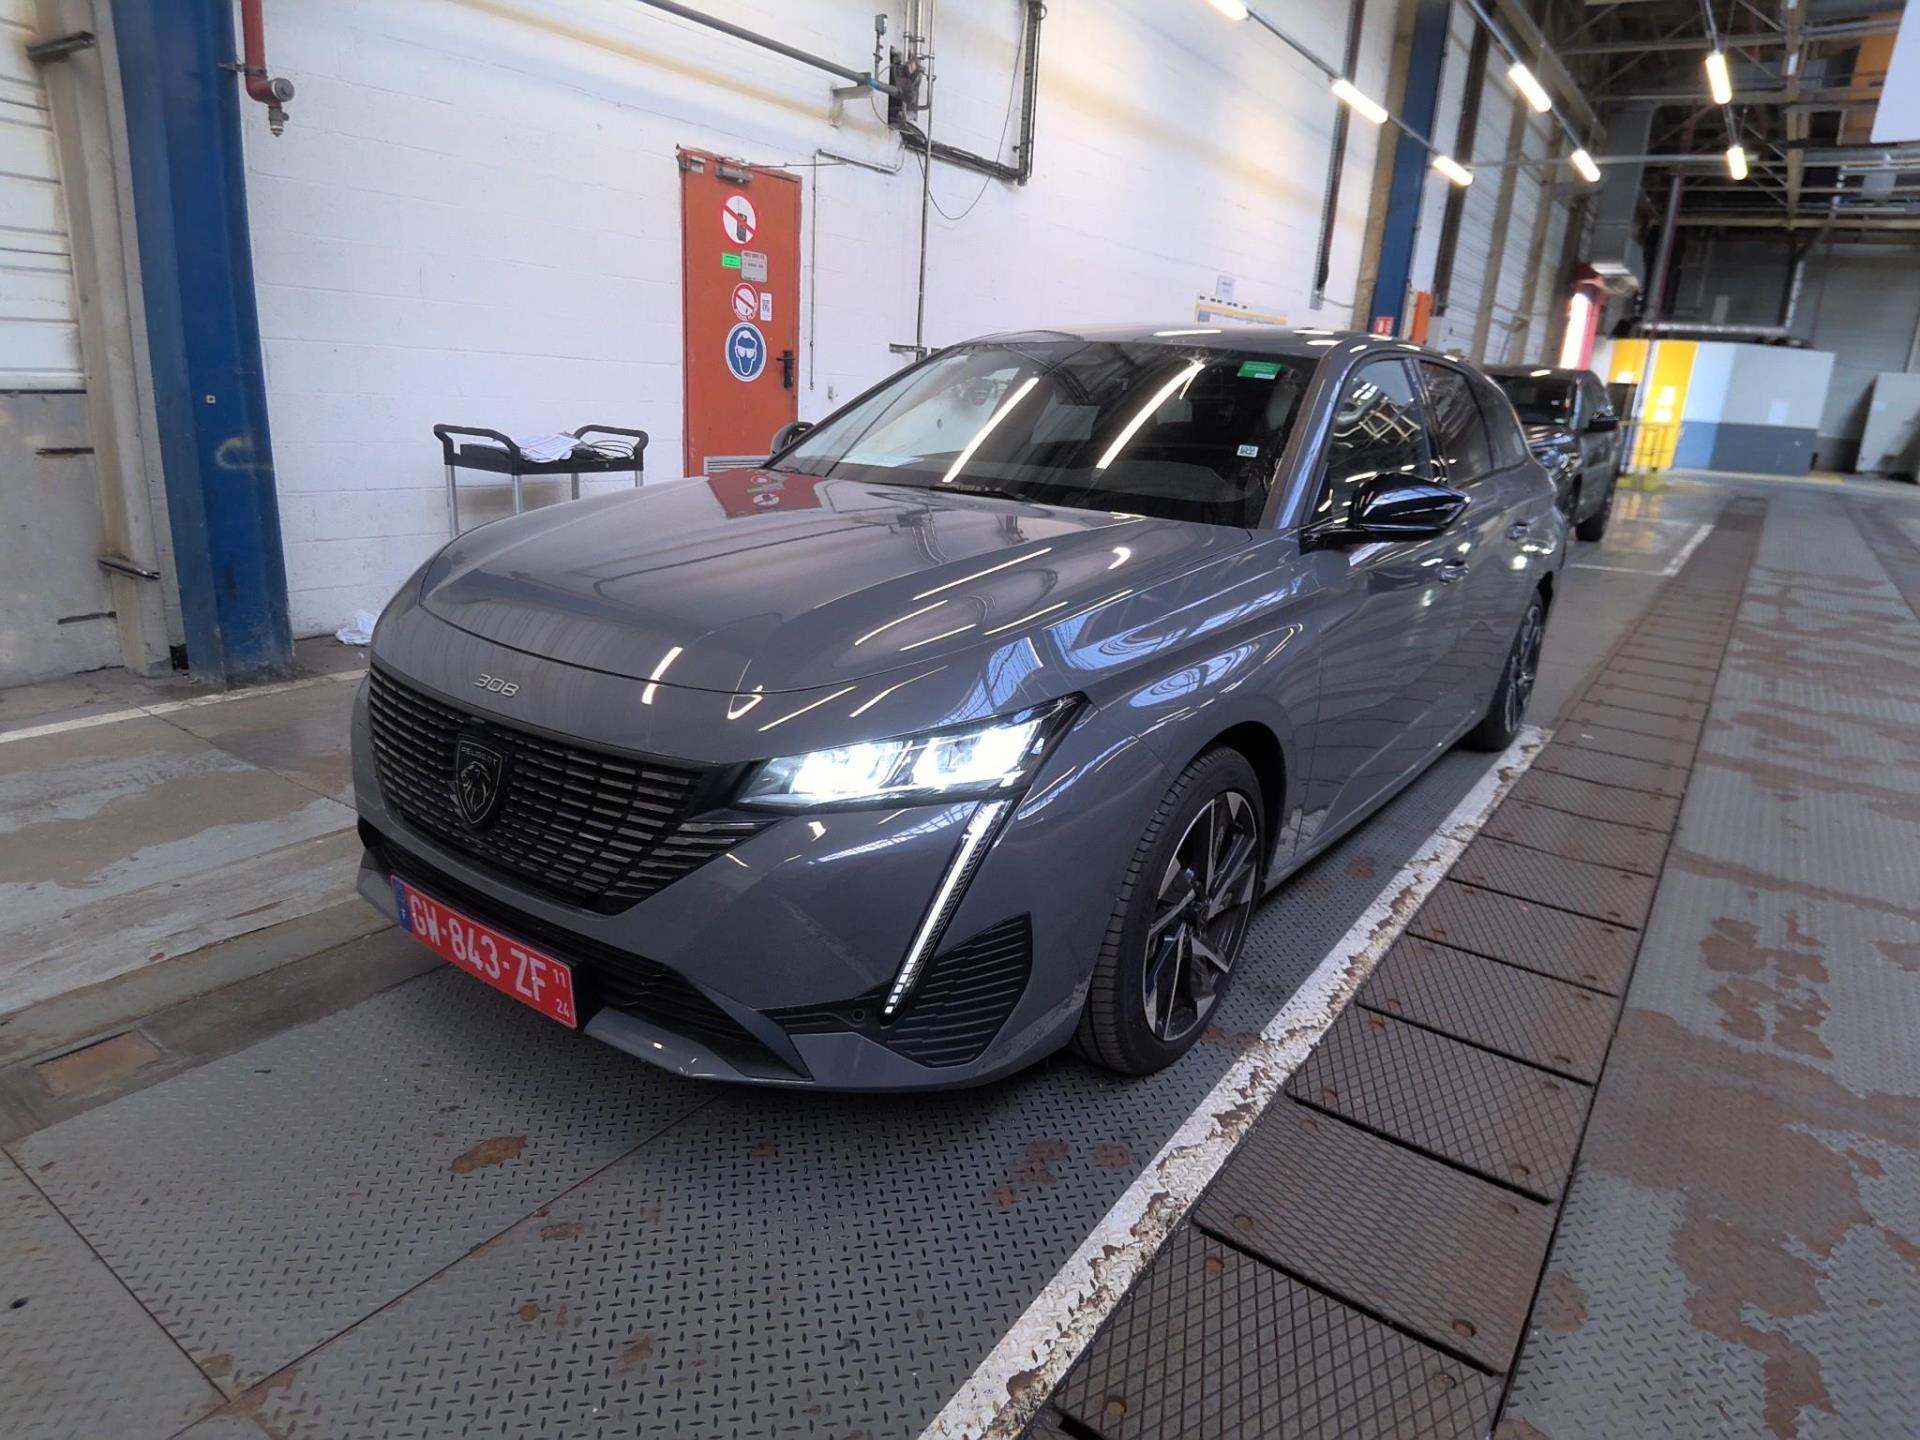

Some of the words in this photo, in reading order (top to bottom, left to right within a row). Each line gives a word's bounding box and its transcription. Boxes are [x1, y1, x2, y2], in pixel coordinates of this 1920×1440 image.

[473, 673, 519, 697] 308
[410, 894, 547, 1002] GW-843-ZF
[552, 968, 567, 988] 11
[556, 998, 571, 1018] 24
